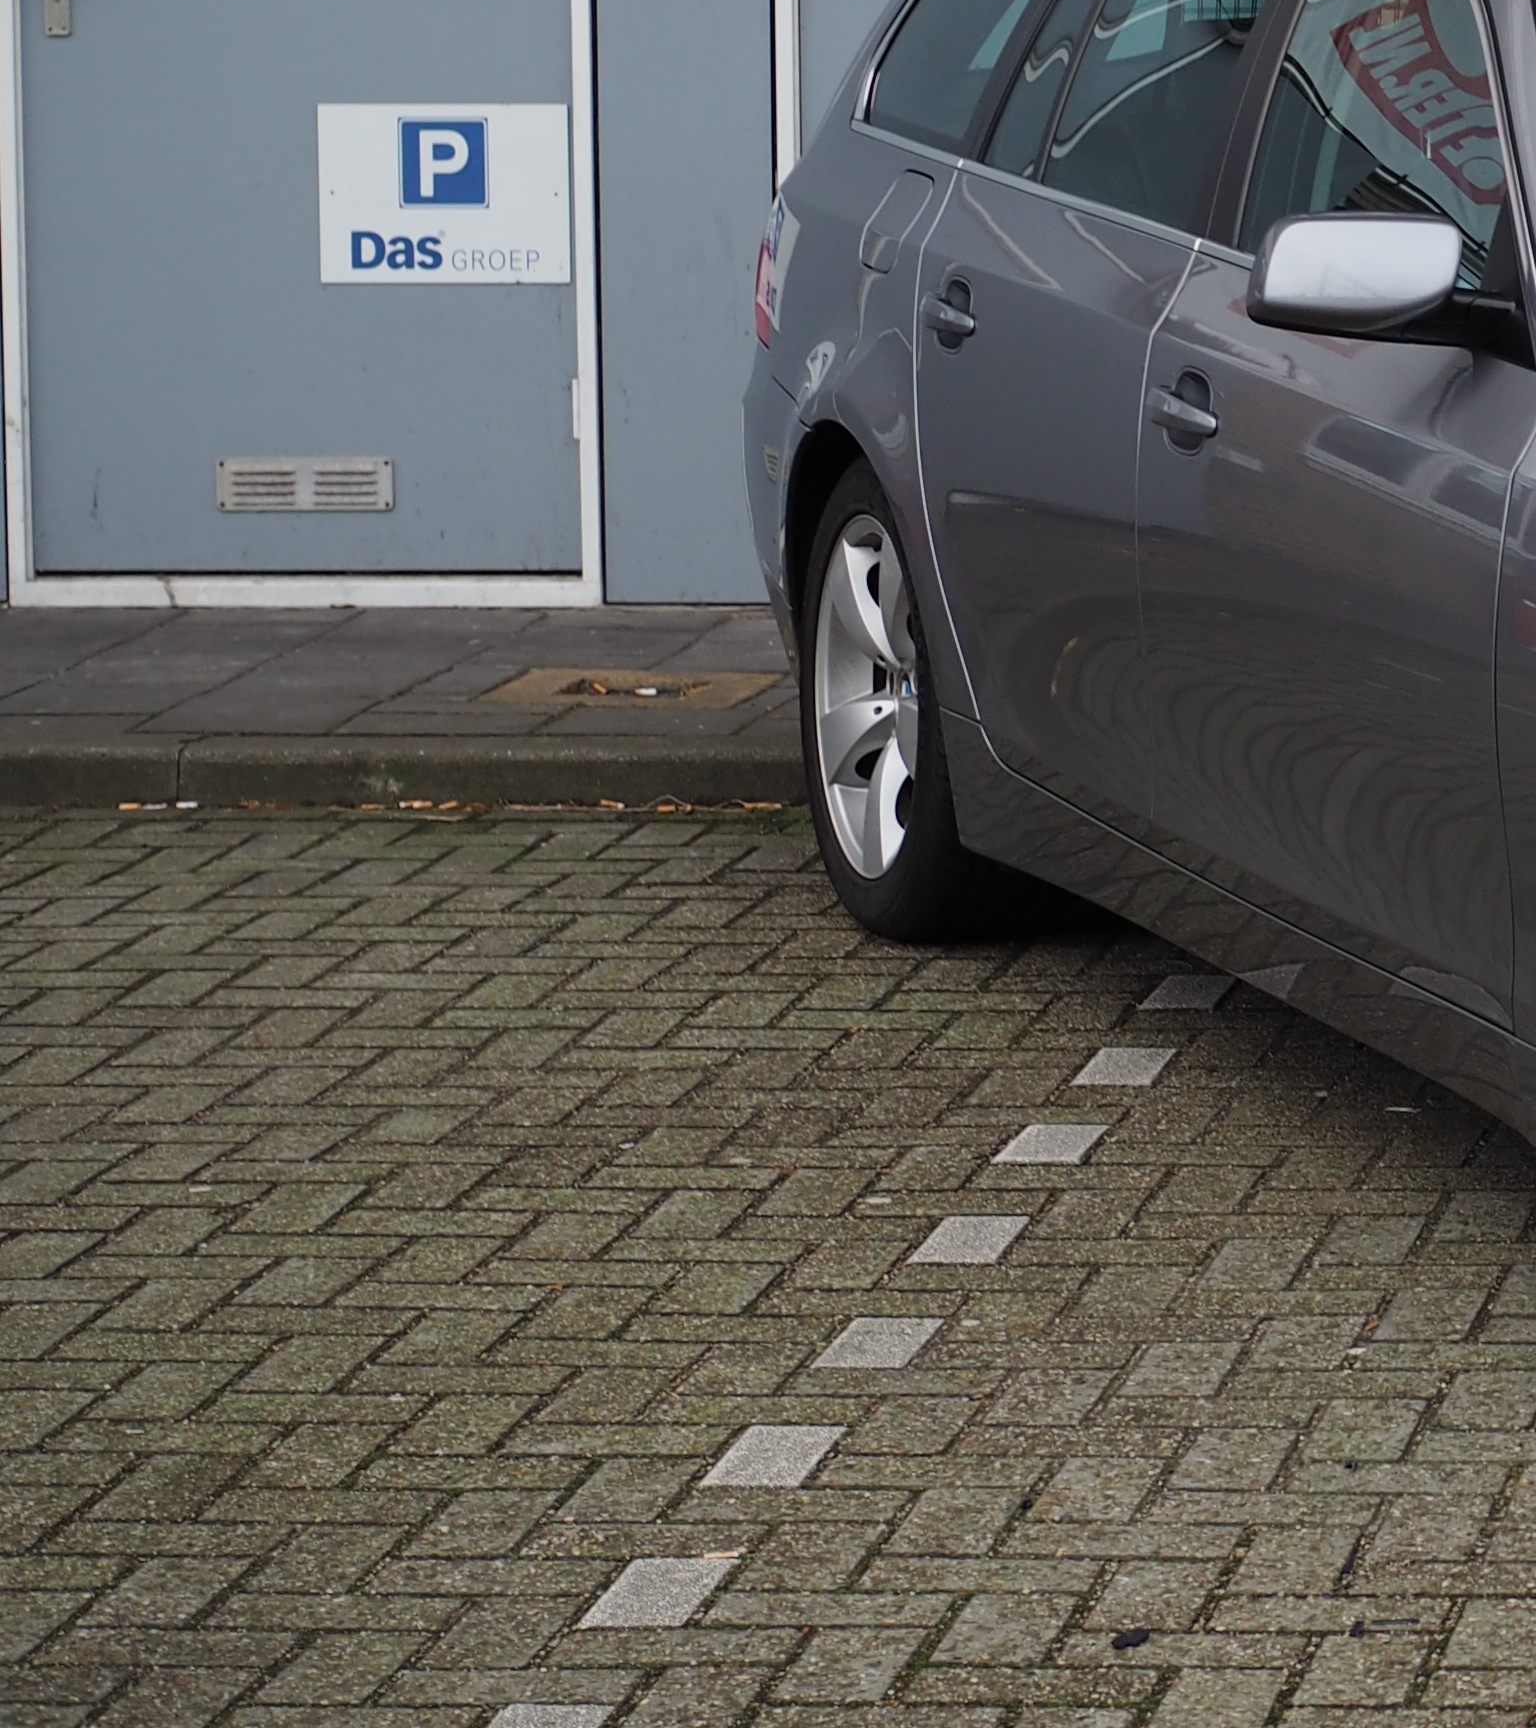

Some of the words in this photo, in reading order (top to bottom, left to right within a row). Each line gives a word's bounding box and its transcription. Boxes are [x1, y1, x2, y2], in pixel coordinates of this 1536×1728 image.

[418, 128, 469, 198] P
[351, 230, 443, 271] Das
[451, 249, 540, 272] GROEP
